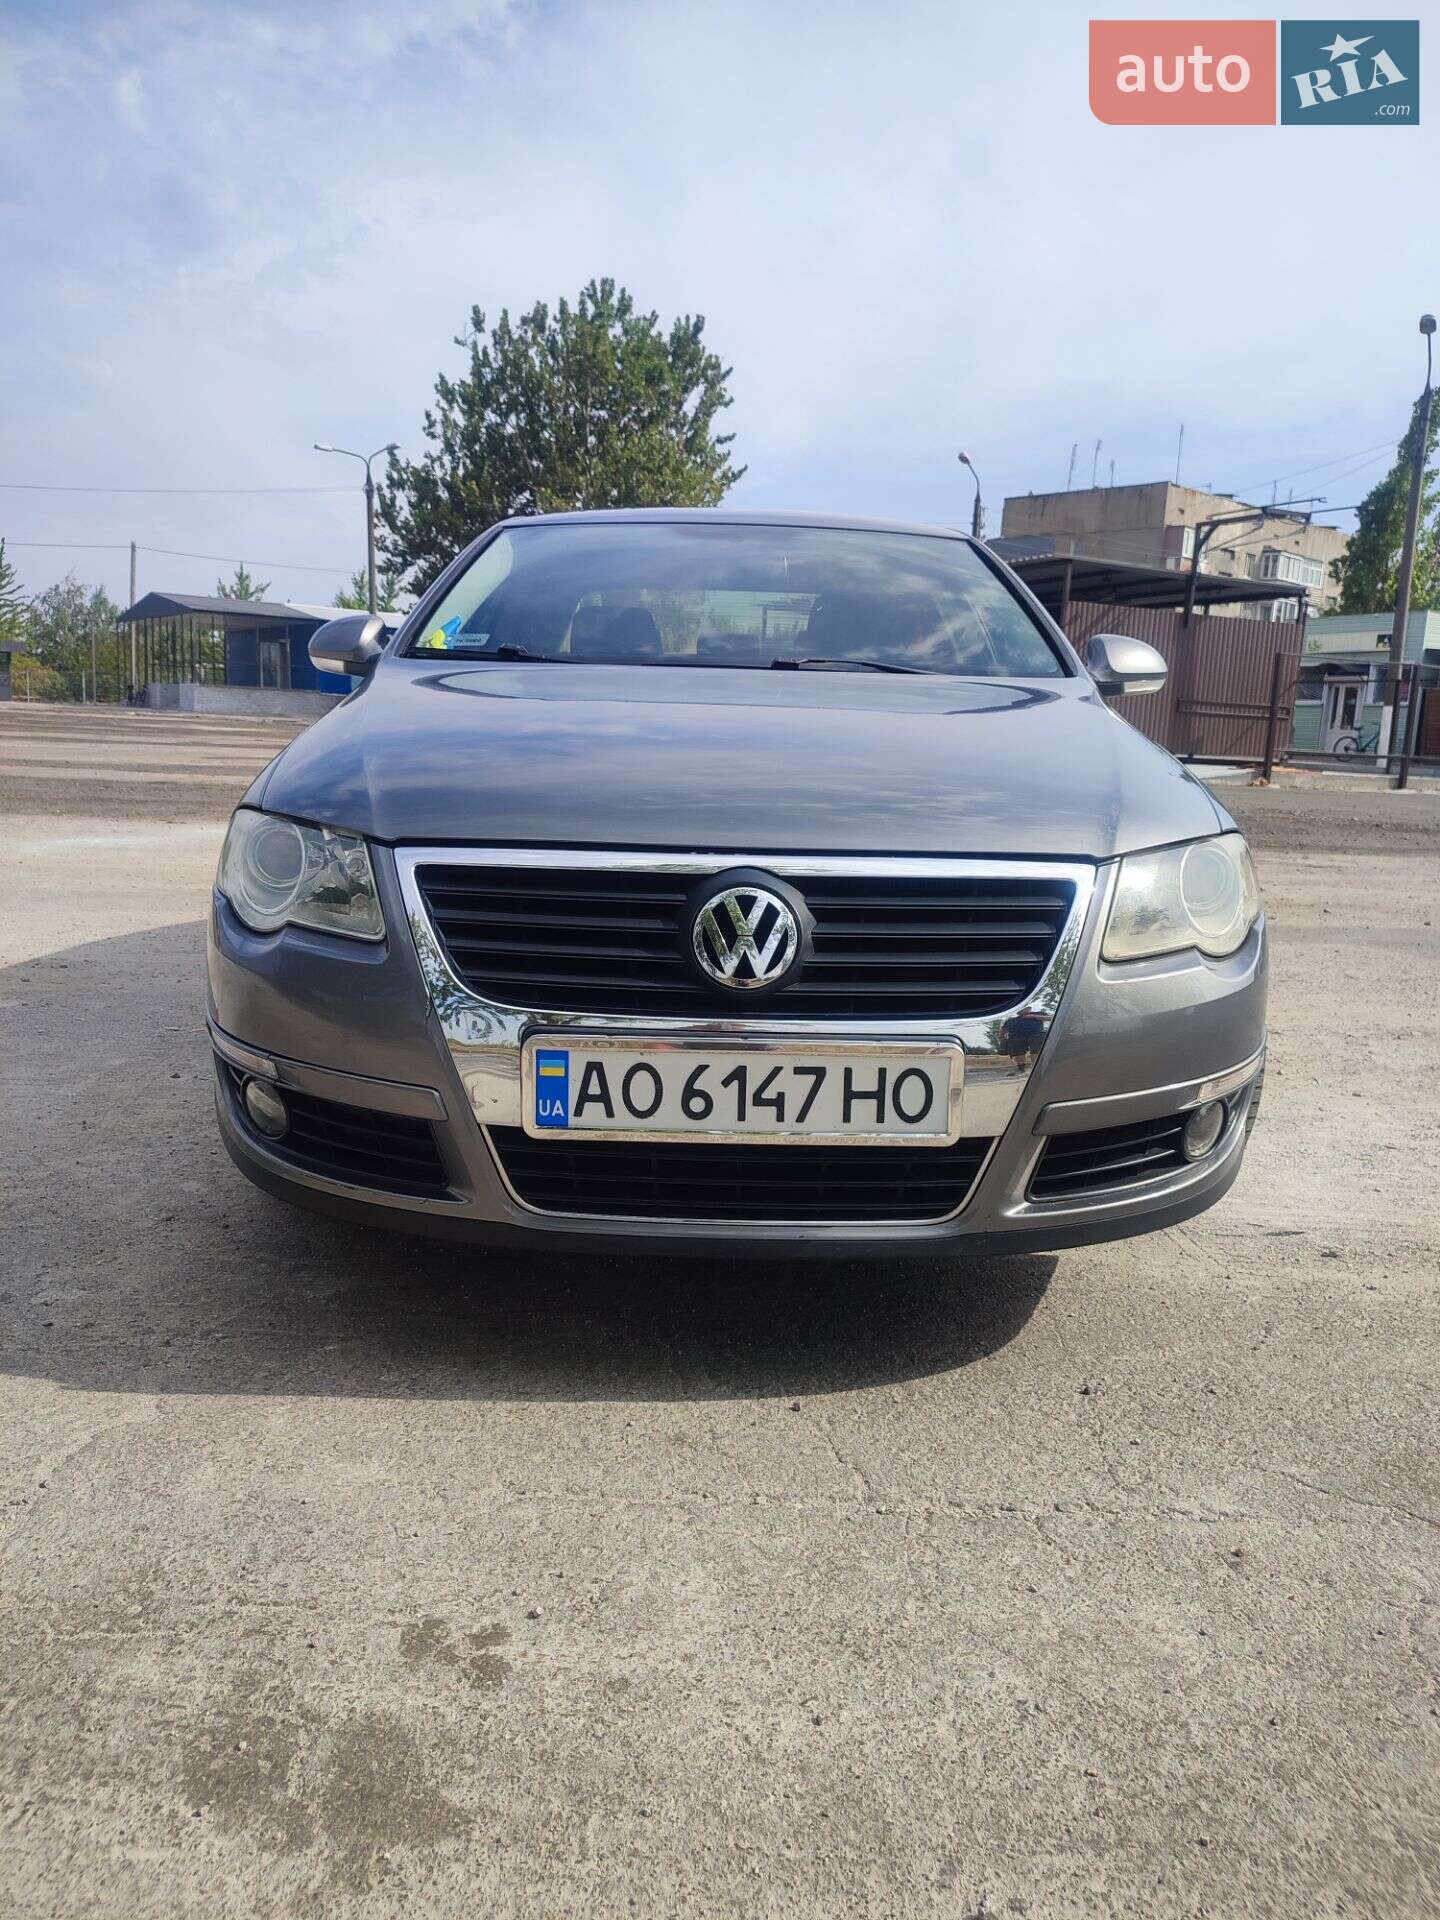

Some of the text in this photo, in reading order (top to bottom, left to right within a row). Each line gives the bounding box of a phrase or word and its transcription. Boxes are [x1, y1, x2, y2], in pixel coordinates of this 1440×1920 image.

[539, 1099, 565, 1117] UA
[573, 1061, 934, 1124] AO 6147 HO
